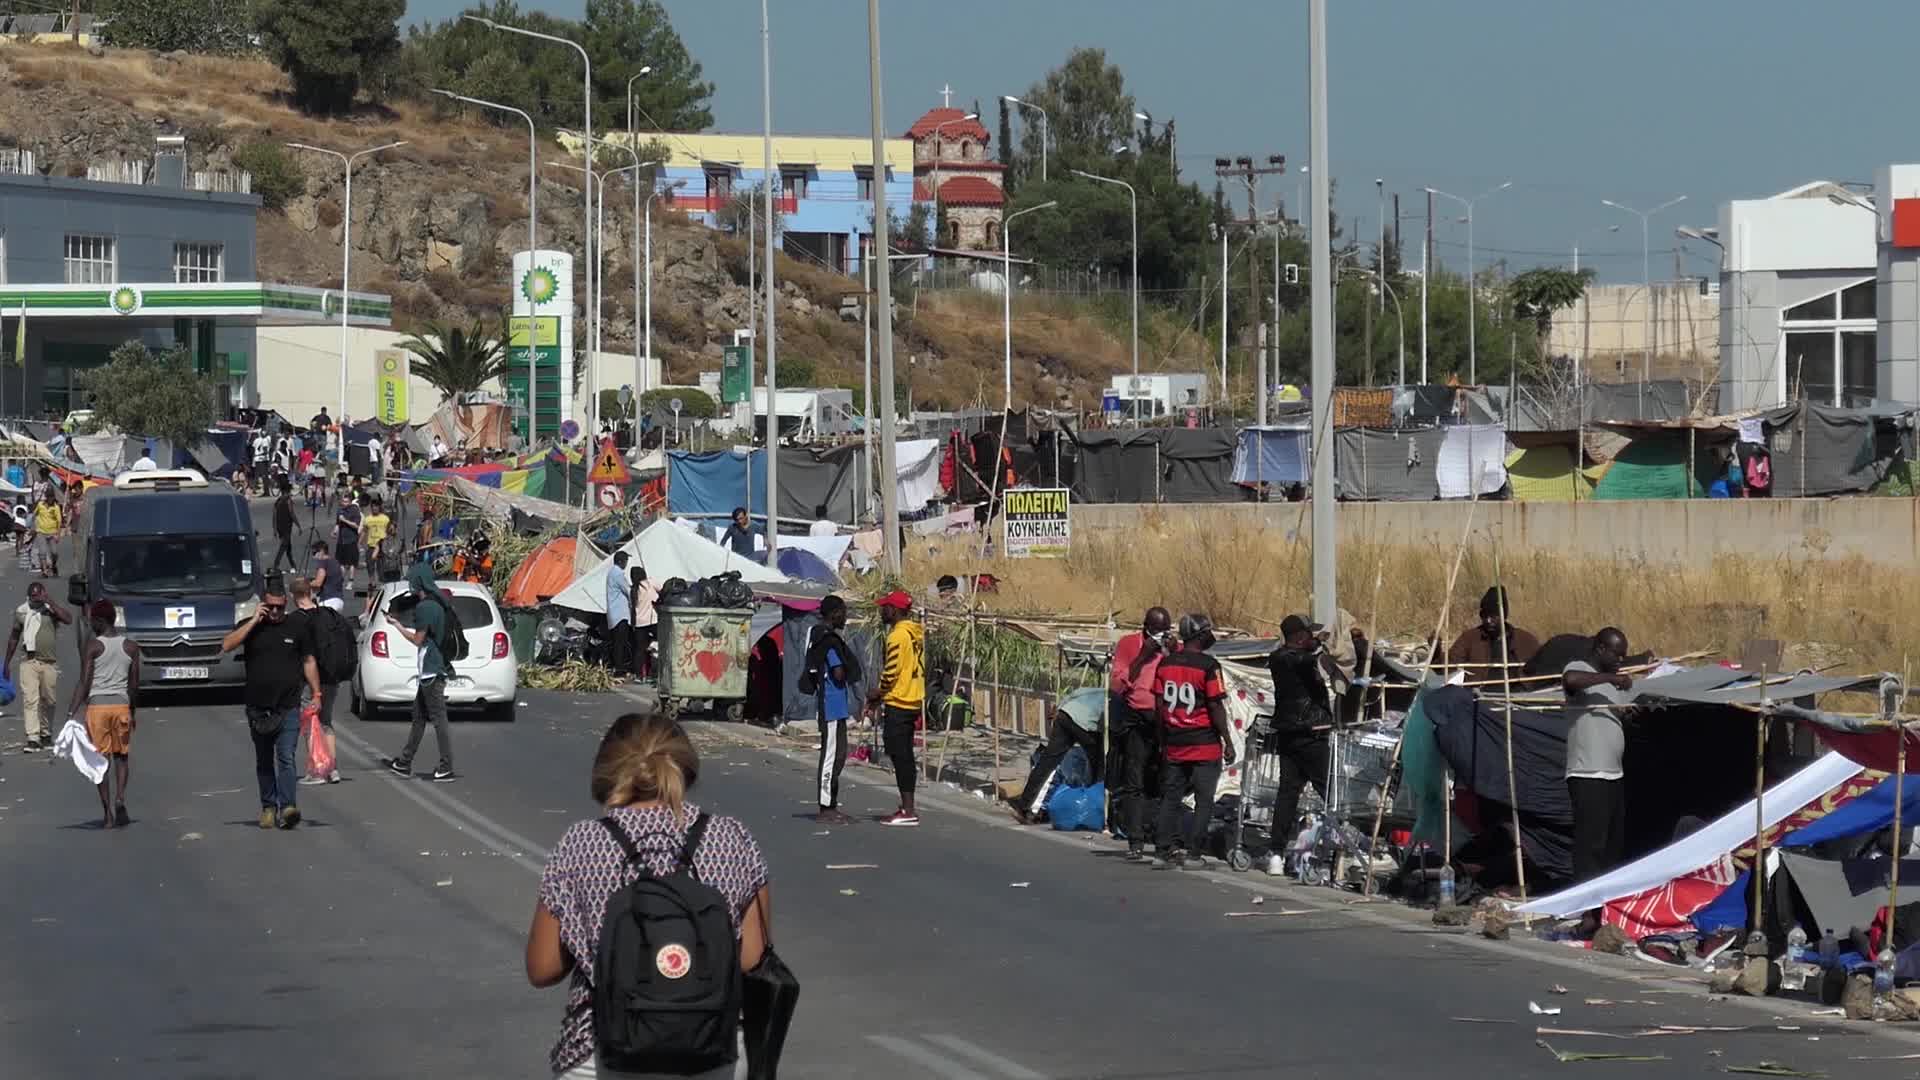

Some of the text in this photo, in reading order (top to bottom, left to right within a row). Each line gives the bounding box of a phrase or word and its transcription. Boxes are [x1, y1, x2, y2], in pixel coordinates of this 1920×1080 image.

[551, 257, 563, 268] bp
[1007, 492, 1066, 513] ΠΩΛΕΙΤΑΙ
[1008, 521, 1066, 537] ΚΟΥΝΕΛΛΗΣ
[1163, 680, 1196, 715] 99
